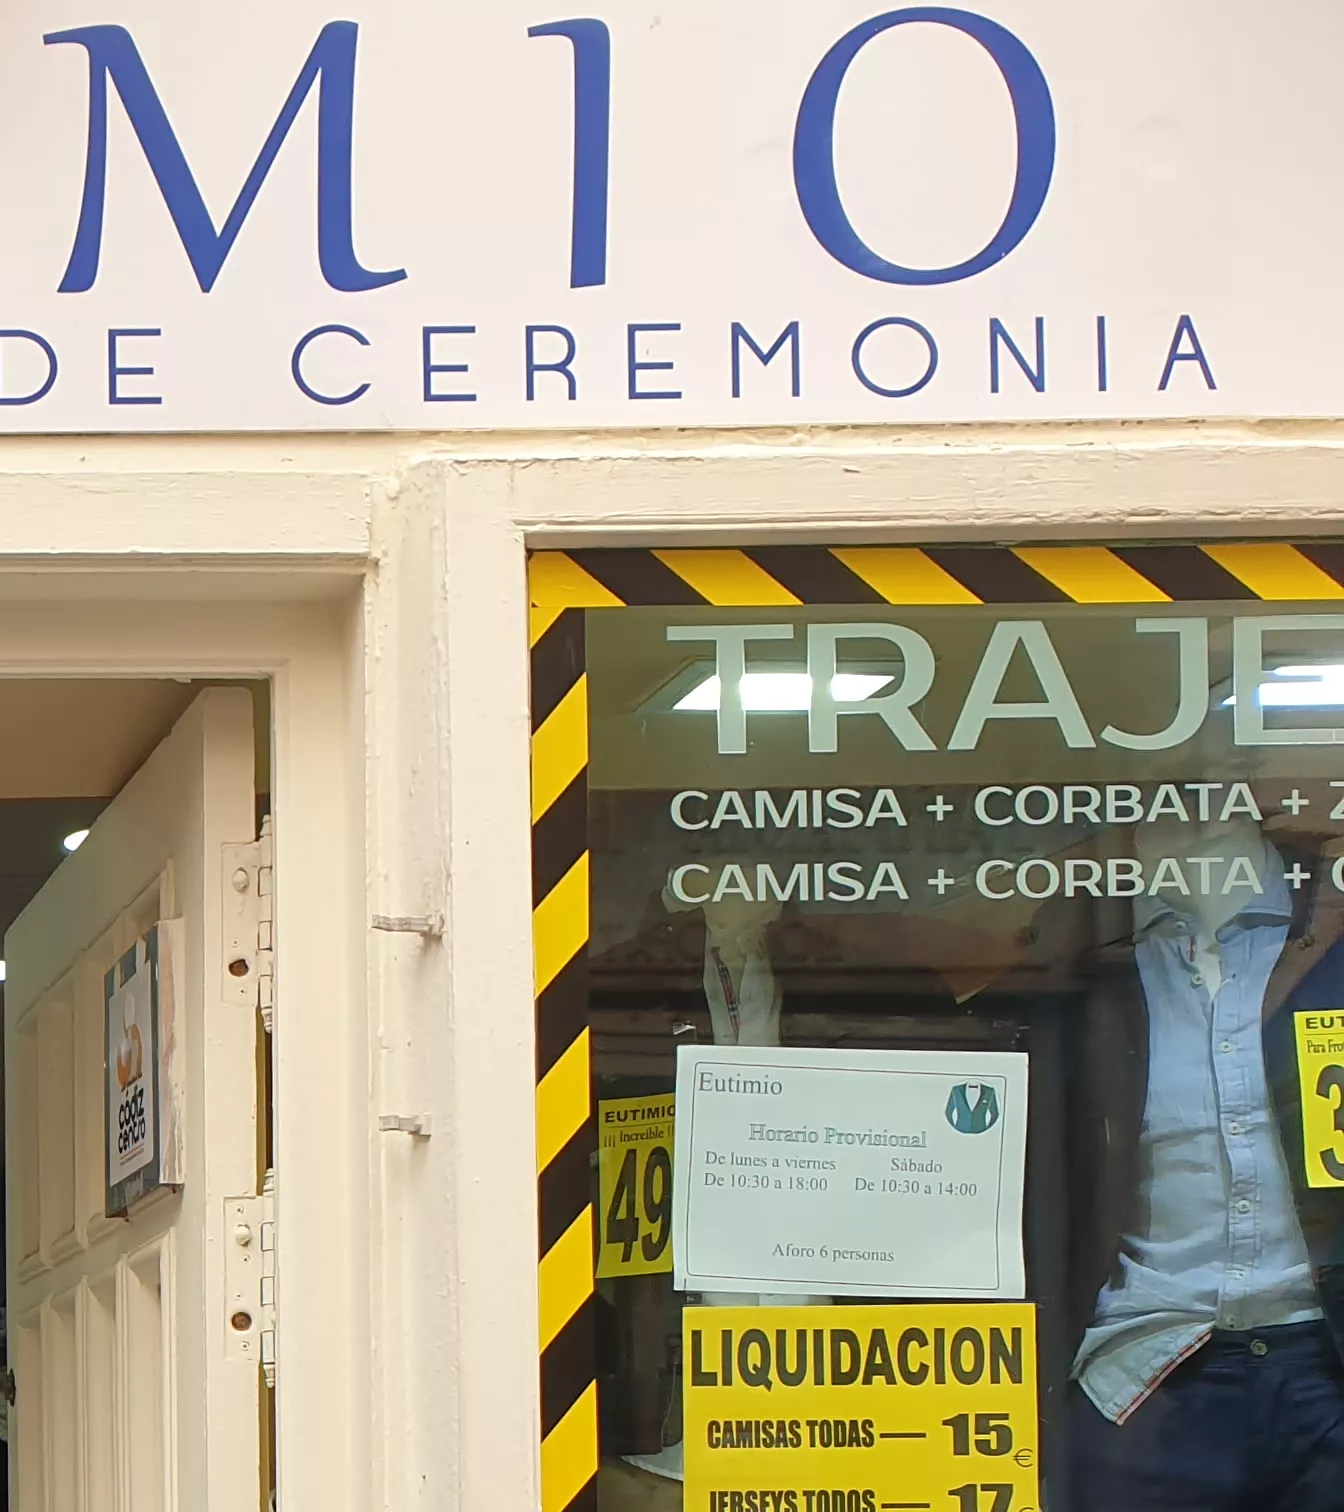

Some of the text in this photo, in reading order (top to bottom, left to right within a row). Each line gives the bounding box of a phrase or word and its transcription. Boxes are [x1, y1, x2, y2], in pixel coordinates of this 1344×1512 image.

[290, 315, 1218, 406] CEREMONIA
[665, 614, 1344, 755] TRAJE
[669, 787, 908, 832] CAMISA
[973, 781, 1263, 827] CORBATA
[671, 860, 910, 904] CAMISA
[975, 855, 1264, 901] CORBATA
[697, 1071, 784, 1096] Eutimio
[117, 1116, 146, 1155] centro
[619, 1125, 665, 1143] Increible
[748, 1122, 927, 1149] Horario Provisional
[704, 1150, 837, 1171] De lunes a viernes
[890, 1157, 943, 1174] Sábado
[703, 1172, 828, 1192] De 10:30 a 18:00
[854, 1177, 978, 1197] De 10:30 a 14:00
[605, 1145, 673, 1264] 49
[771, 1243, 895, 1263] Aforo 6 personas
[690, 1326, 1024, 1391] LIQUIDACION
[706, 1418, 802, 1450] CAMISAS
[808, 1418, 875, 1449] TODAS
